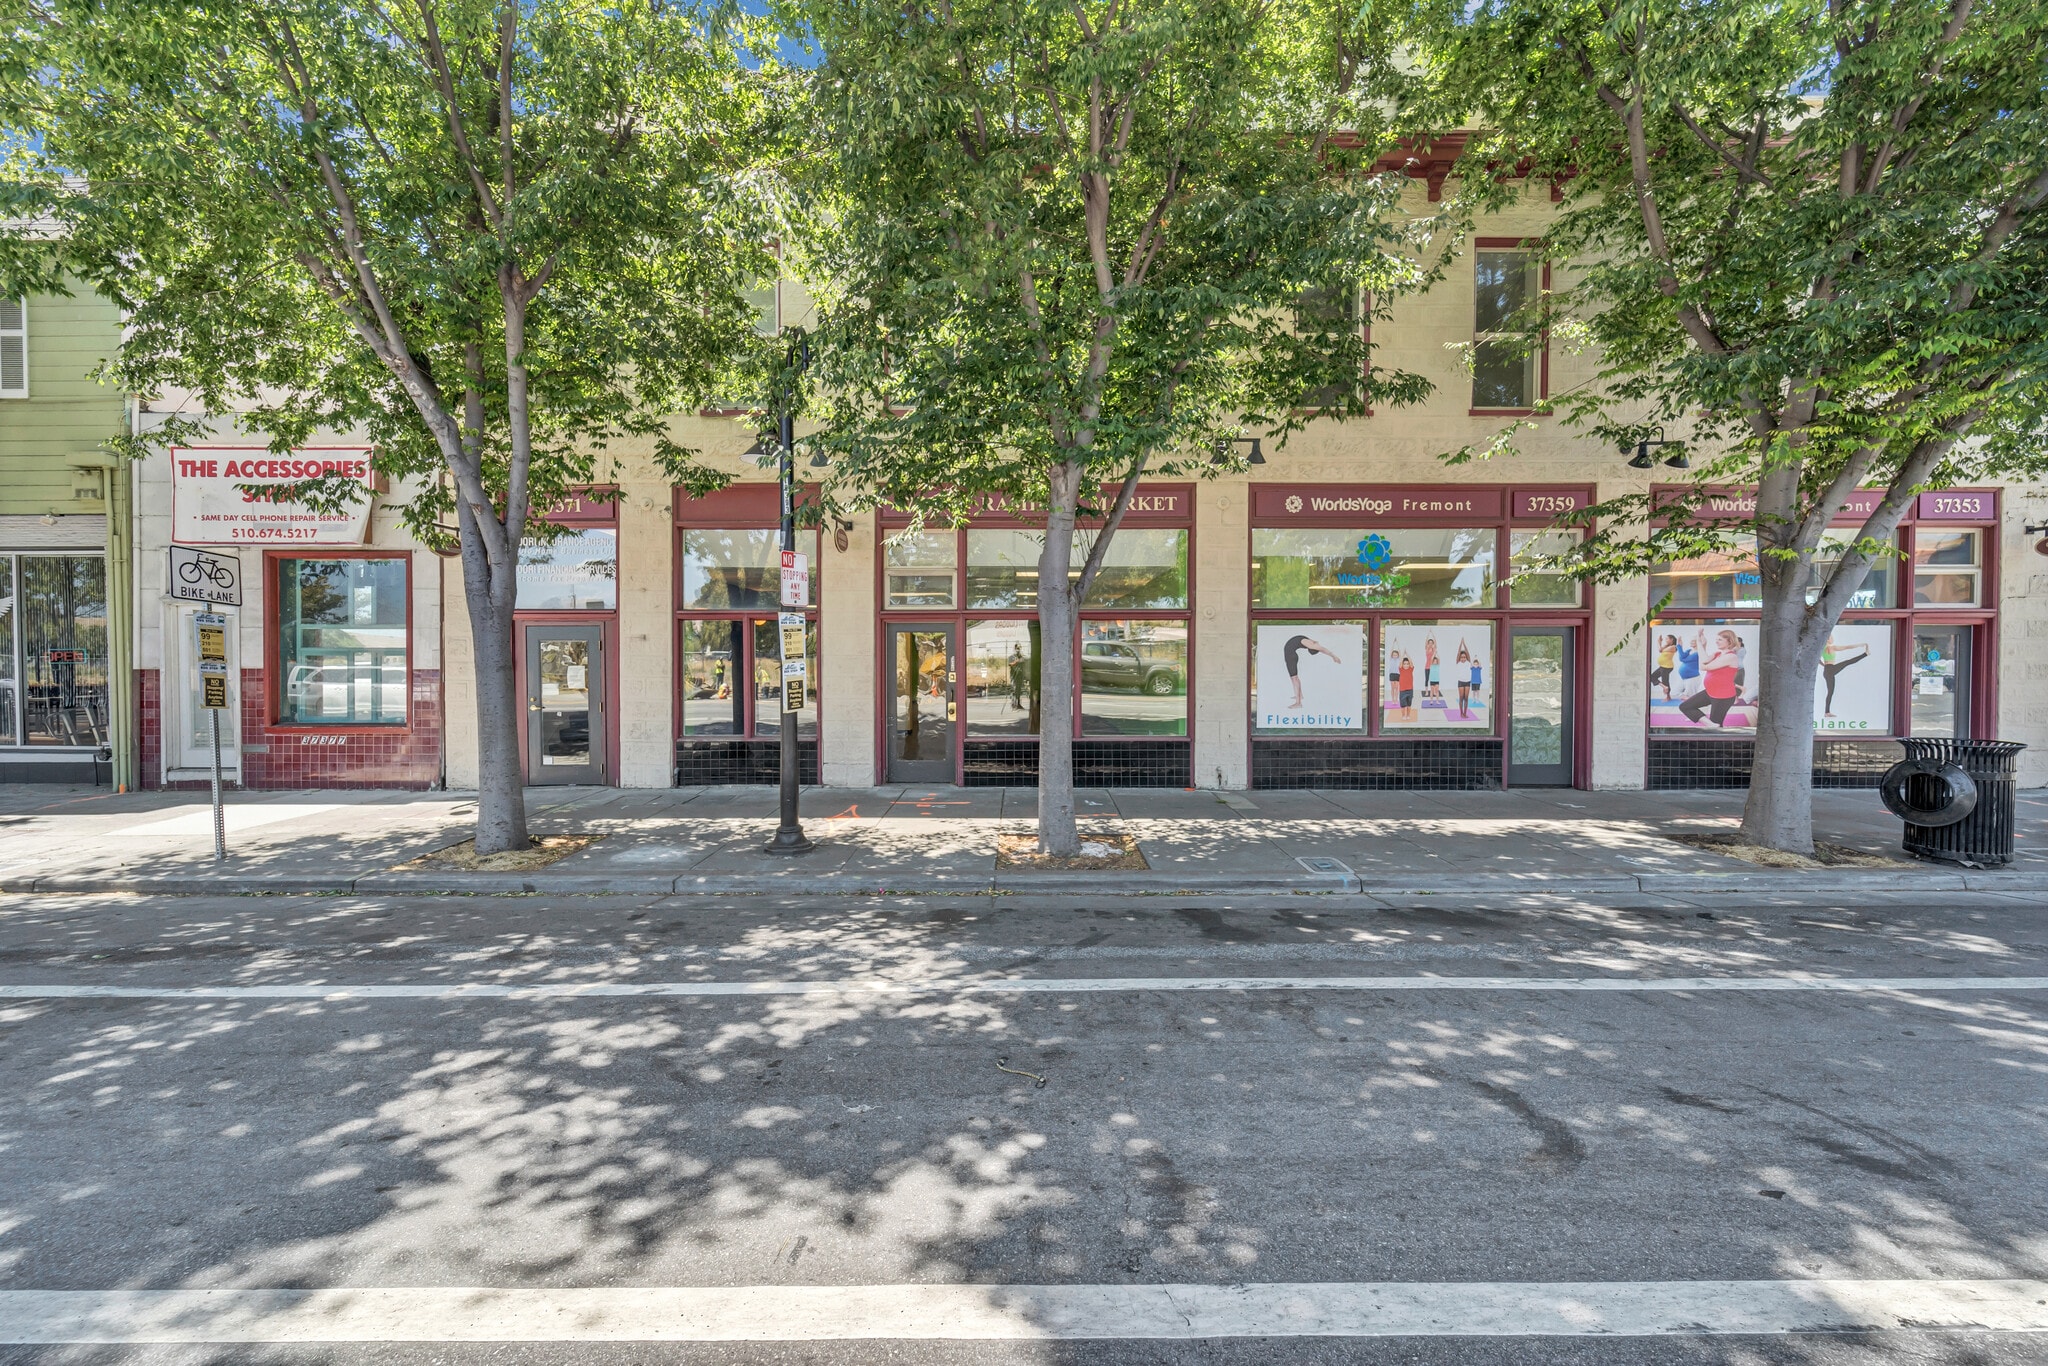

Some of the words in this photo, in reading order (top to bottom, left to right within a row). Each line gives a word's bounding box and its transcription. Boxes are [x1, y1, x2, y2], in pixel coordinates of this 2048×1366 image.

[178, 460, 218, 478] THE
[224, 460, 367, 479] ACCESSORIES
[1090, 496, 1178, 511] MRKET
[1311, 497, 1393, 515] WorldsYoga
[1403, 498, 1472, 511] Fremont
[1527, 496, 1575, 512] 37359
[1710, 498, 1758, 512] Worlds
[1933, 498, 1981, 513] 37353
[241, 514, 258, 522] CELL
[259, 514, 288, 522] PHONE
[290, 514, 316, 522] REPAIR
[318, 514, 349, 522] SERVICE
[232, 528, 318, 539] 510.674.5217
[538, 537, 585, 547] INURANCE
[782, 553, 793, 566] NO
[783, 569, 808, 582] STOPPING
[790, 582, 800, 590] ANY
[181, 586, 205, 599] BIKE
[210, 590, 235, 603] LANE
[790, 591, 801, 600] TIME
[201, 632, 211, 640] 99
[784, 632, 793, 640] 99
[43, 651, 84, 662] OPEN
[1267, 714, 1352, 726] Flexibility
[1812, 718, 1868, 729] alance
[302, 736, 346, 744] 37377
